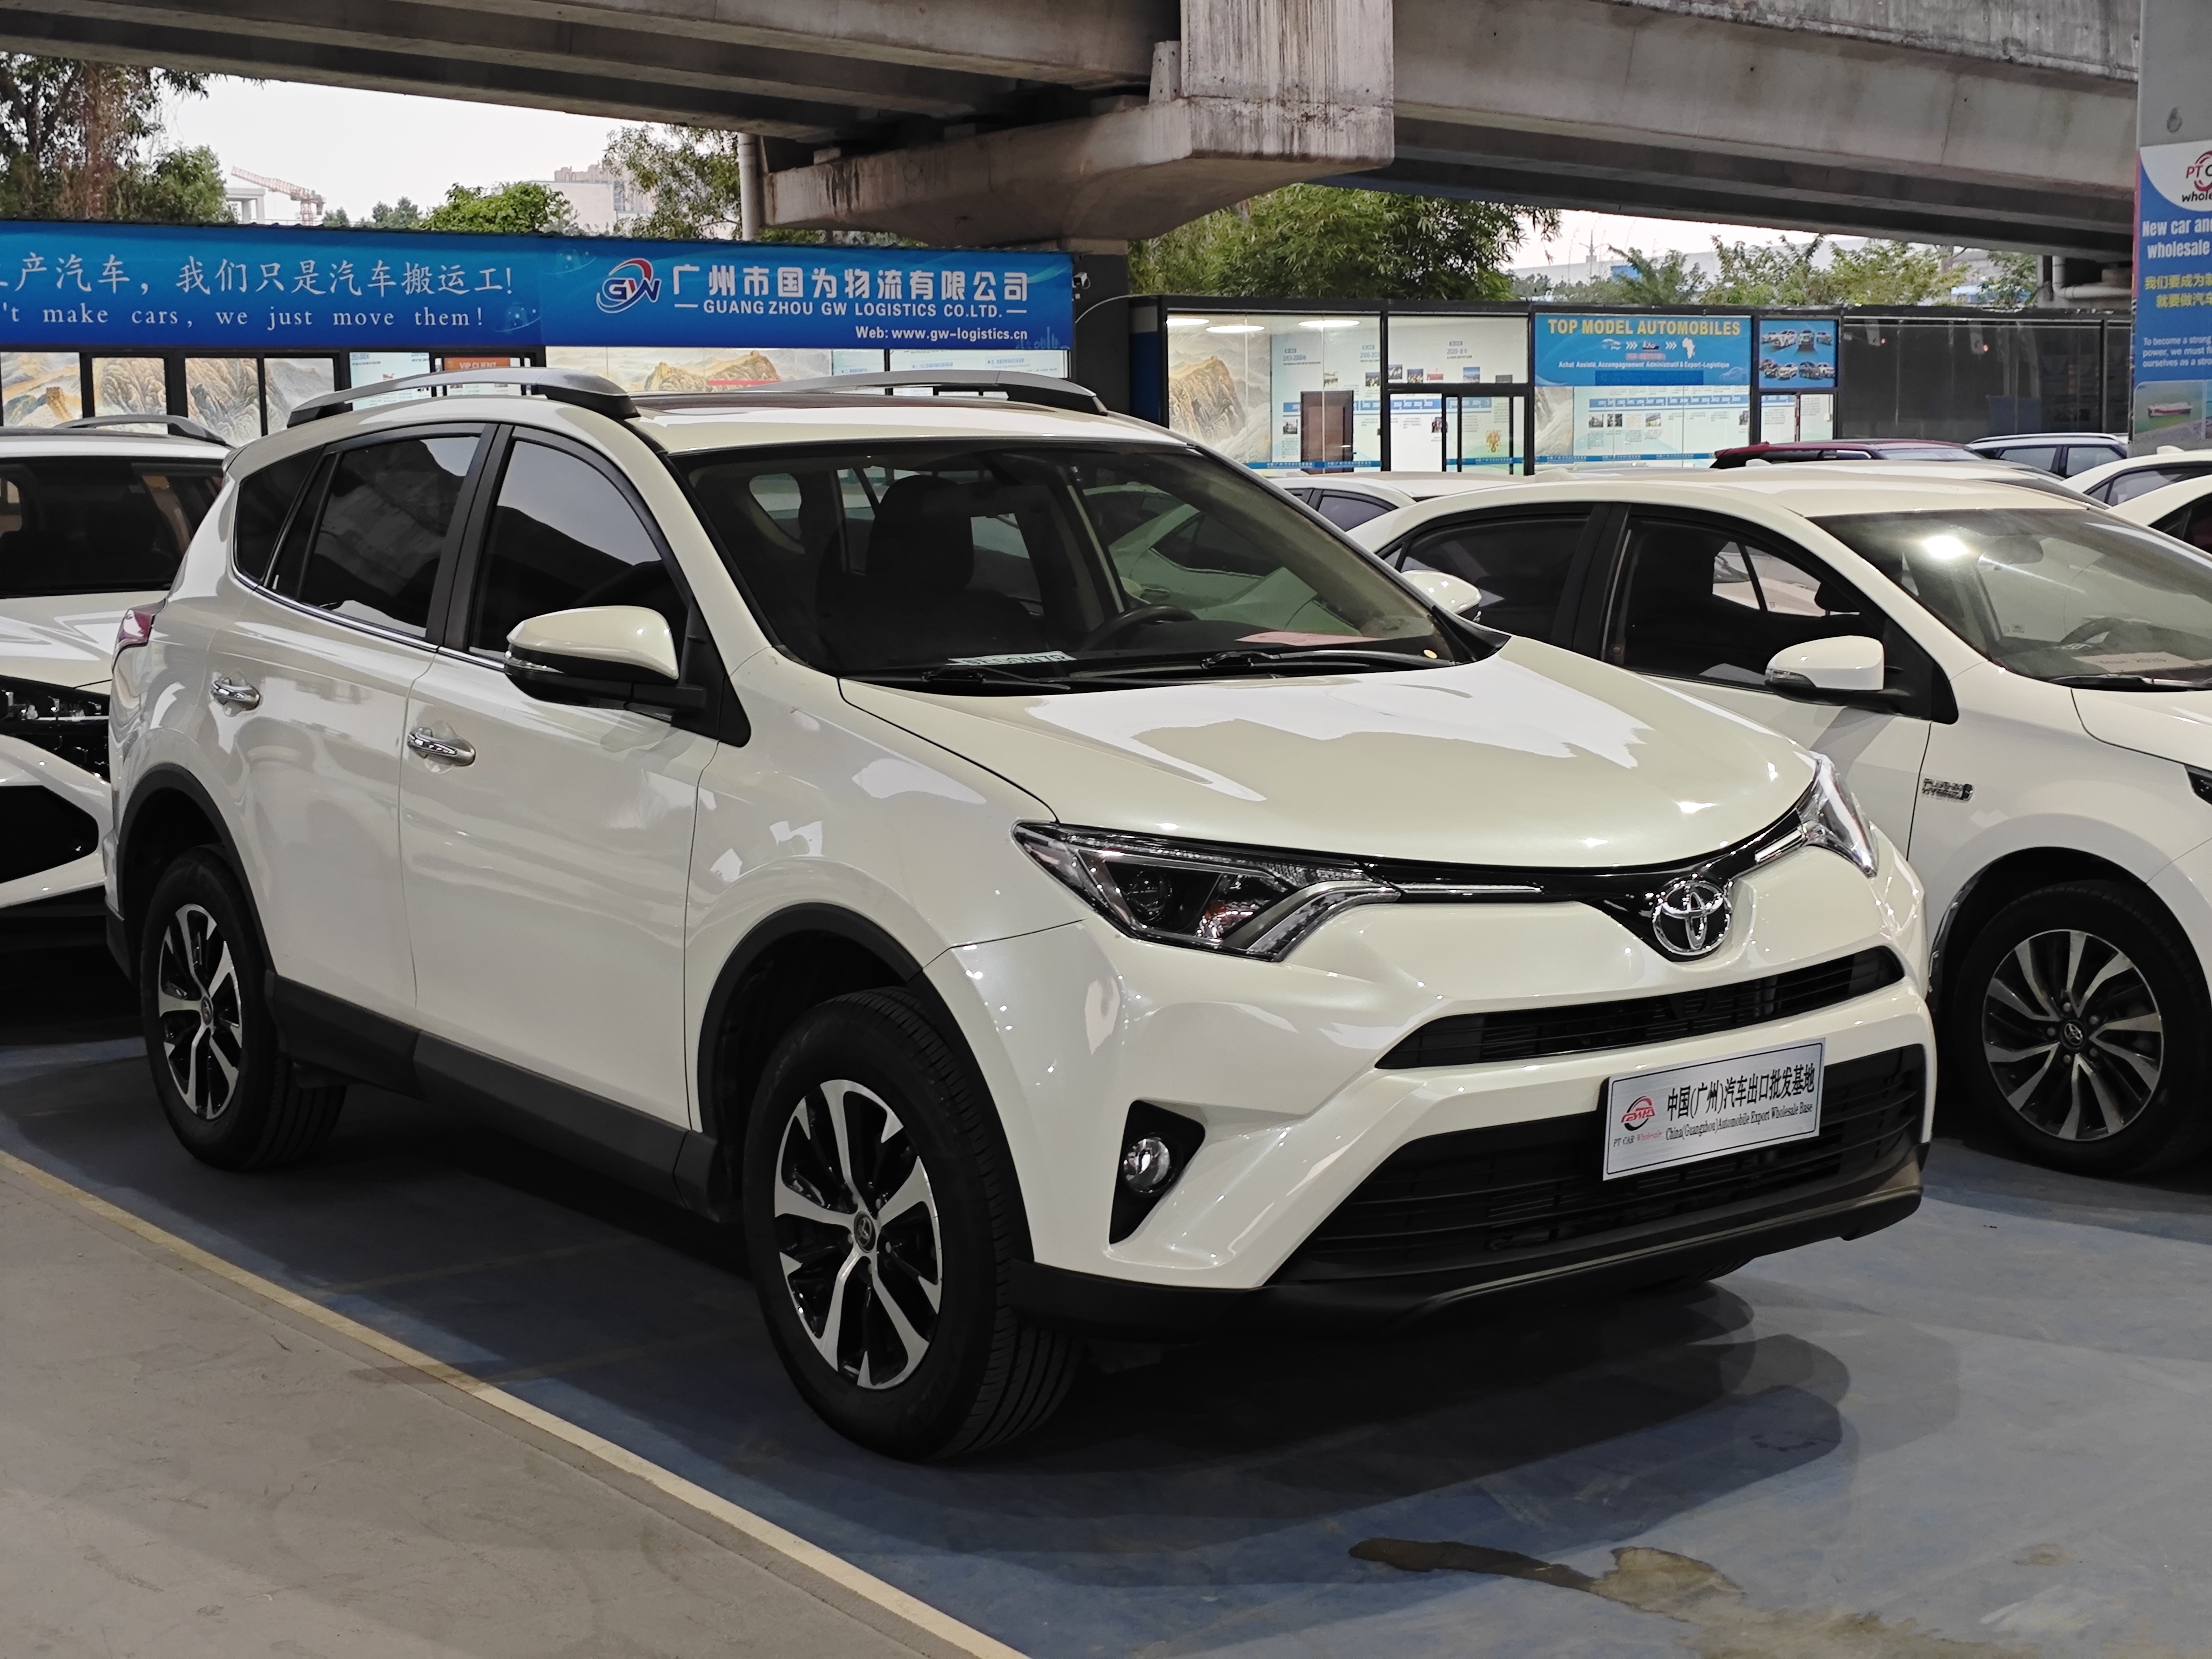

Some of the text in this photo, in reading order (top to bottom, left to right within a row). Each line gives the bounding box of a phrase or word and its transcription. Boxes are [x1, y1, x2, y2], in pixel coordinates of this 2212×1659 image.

[2186, 165, 2203, 179] PT
[2142, 218, 2212, 237] New car an
[2147, 239, 2210, 259] wholesale
[0, 252, 513, 298] 产汽车，我们只是汽车搬运工!
[672, 264, 1028, 302] 广州市国为物流有限公司
[43, 302, 109, 323] make
[131, 309, 193, 328] cars,
[216, 311, 248, 325] we
[267, 306, 312, 331] just
[333, 312, 394, 326] move
[414, 306, 483, 326] them!
[703, 299, 1002, 318] GUANG ZHOU GW LOGISTICS CO.LTD.
[855, 326, 1028, 342] Web: www.gw-logistics.cn
[1548, 319, 1741, 336] TOP MODEL AUTOMOBILES
[1598, 361, 1644, 369] Accompagnement
[1750, 1110, 1770, 1125] Export
[1771, 1103, 1799, 1120] Wholesale
[1799, 1101, 1813, 1114] Base
